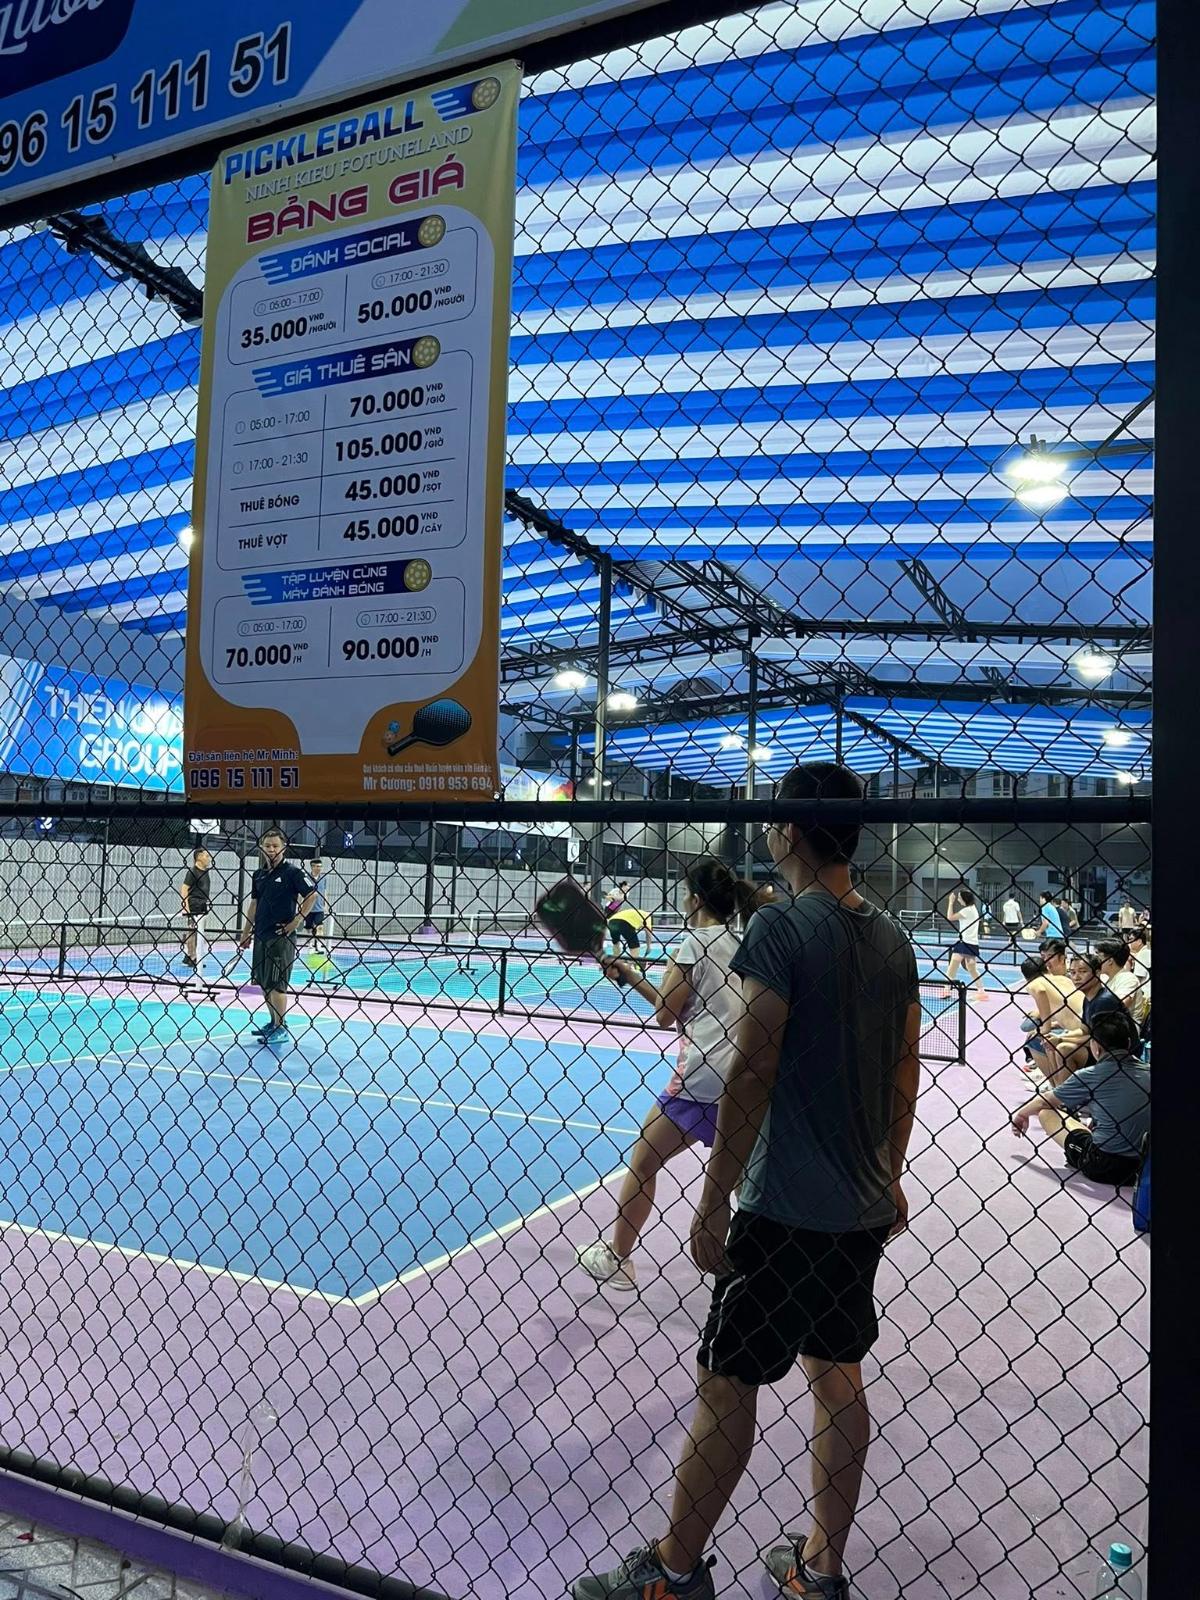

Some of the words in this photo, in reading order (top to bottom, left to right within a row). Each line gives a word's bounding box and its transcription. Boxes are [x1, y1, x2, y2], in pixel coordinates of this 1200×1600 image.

[61, 83, 117, 153] 15
[131, 49, 211, 130] 111
[228, 21, 292, 98] 51
[224, 100, 424, 185] PICKLEBALL
[246, 175, 291, 203] NINH
[341, 125, 474, 177] FOTUNELAND
[246, 185, 369, 244] BẢNG
[388, 154, 465, 205] GIÁ
[290, 247, 339, 273] ĐÁNH
[344, 231, 411, 261] SOCIAL
[390, 270, 413, 284] 17:00
[420, 264, 445, 278] 21:30
[298, 291, 320, 305] 17:00
[357, 289, 433, 324] 50.000
[240, 316, 308, 349] 35.000
[284, 364, 312, 387] GIÁ
[317, 355, 366, 381] THUÊ
[371, 348, 411, 371] SÂN
[350, 386, 425, 418] 70.000
[250, 417, 276, 432] 05:00
[285, 410, 310, 426] 17:00
[336, 430, 423, 462] 105.000
[249, 457, 274, 471] 17:00
[282, 452, 308, 467] 21:30
[345, 472, 421, 502] 45.000
[240, 496, 265, 512] THUÊ
[269, 494, 300, 509] BÓNG
[343, 513, 419, 542] 45.000
[238, 534, 264, 550] THUÊ
[266, 533, 288, 549] VỢT
[309, 569, 349, 585] LUYỆN
[312, 584, 346, 598] ĐÁNH
[349, 581, 385, 595] BÓNG
[253, 621, 275, 633] 05:00
[281, 619, 303, 631] 17:00
[375, 612, 399, 624] 17:00
[407, 610, 432, 622] 21:30
[226, 644, 292, 668] 70.000
[293, 655, 303, 664] /H
[342, 637, 420, 661] 90.000
[421, 649, 432, 657] /H
[79, 733, 180, 777] GROUP
[256, 748, 270, 761] Mr
[190, 768, 220, 790] 096
[226, 767, 246, 789] 15
[250, 766, 273, 789] 111
[280, 766, 300, 789] 51
[363, 776, 378, 791] Mr
[419, 776, 445, 791] 0918
[448, 776, 468, 791] 953
[472, 776, 493, 791] 694
